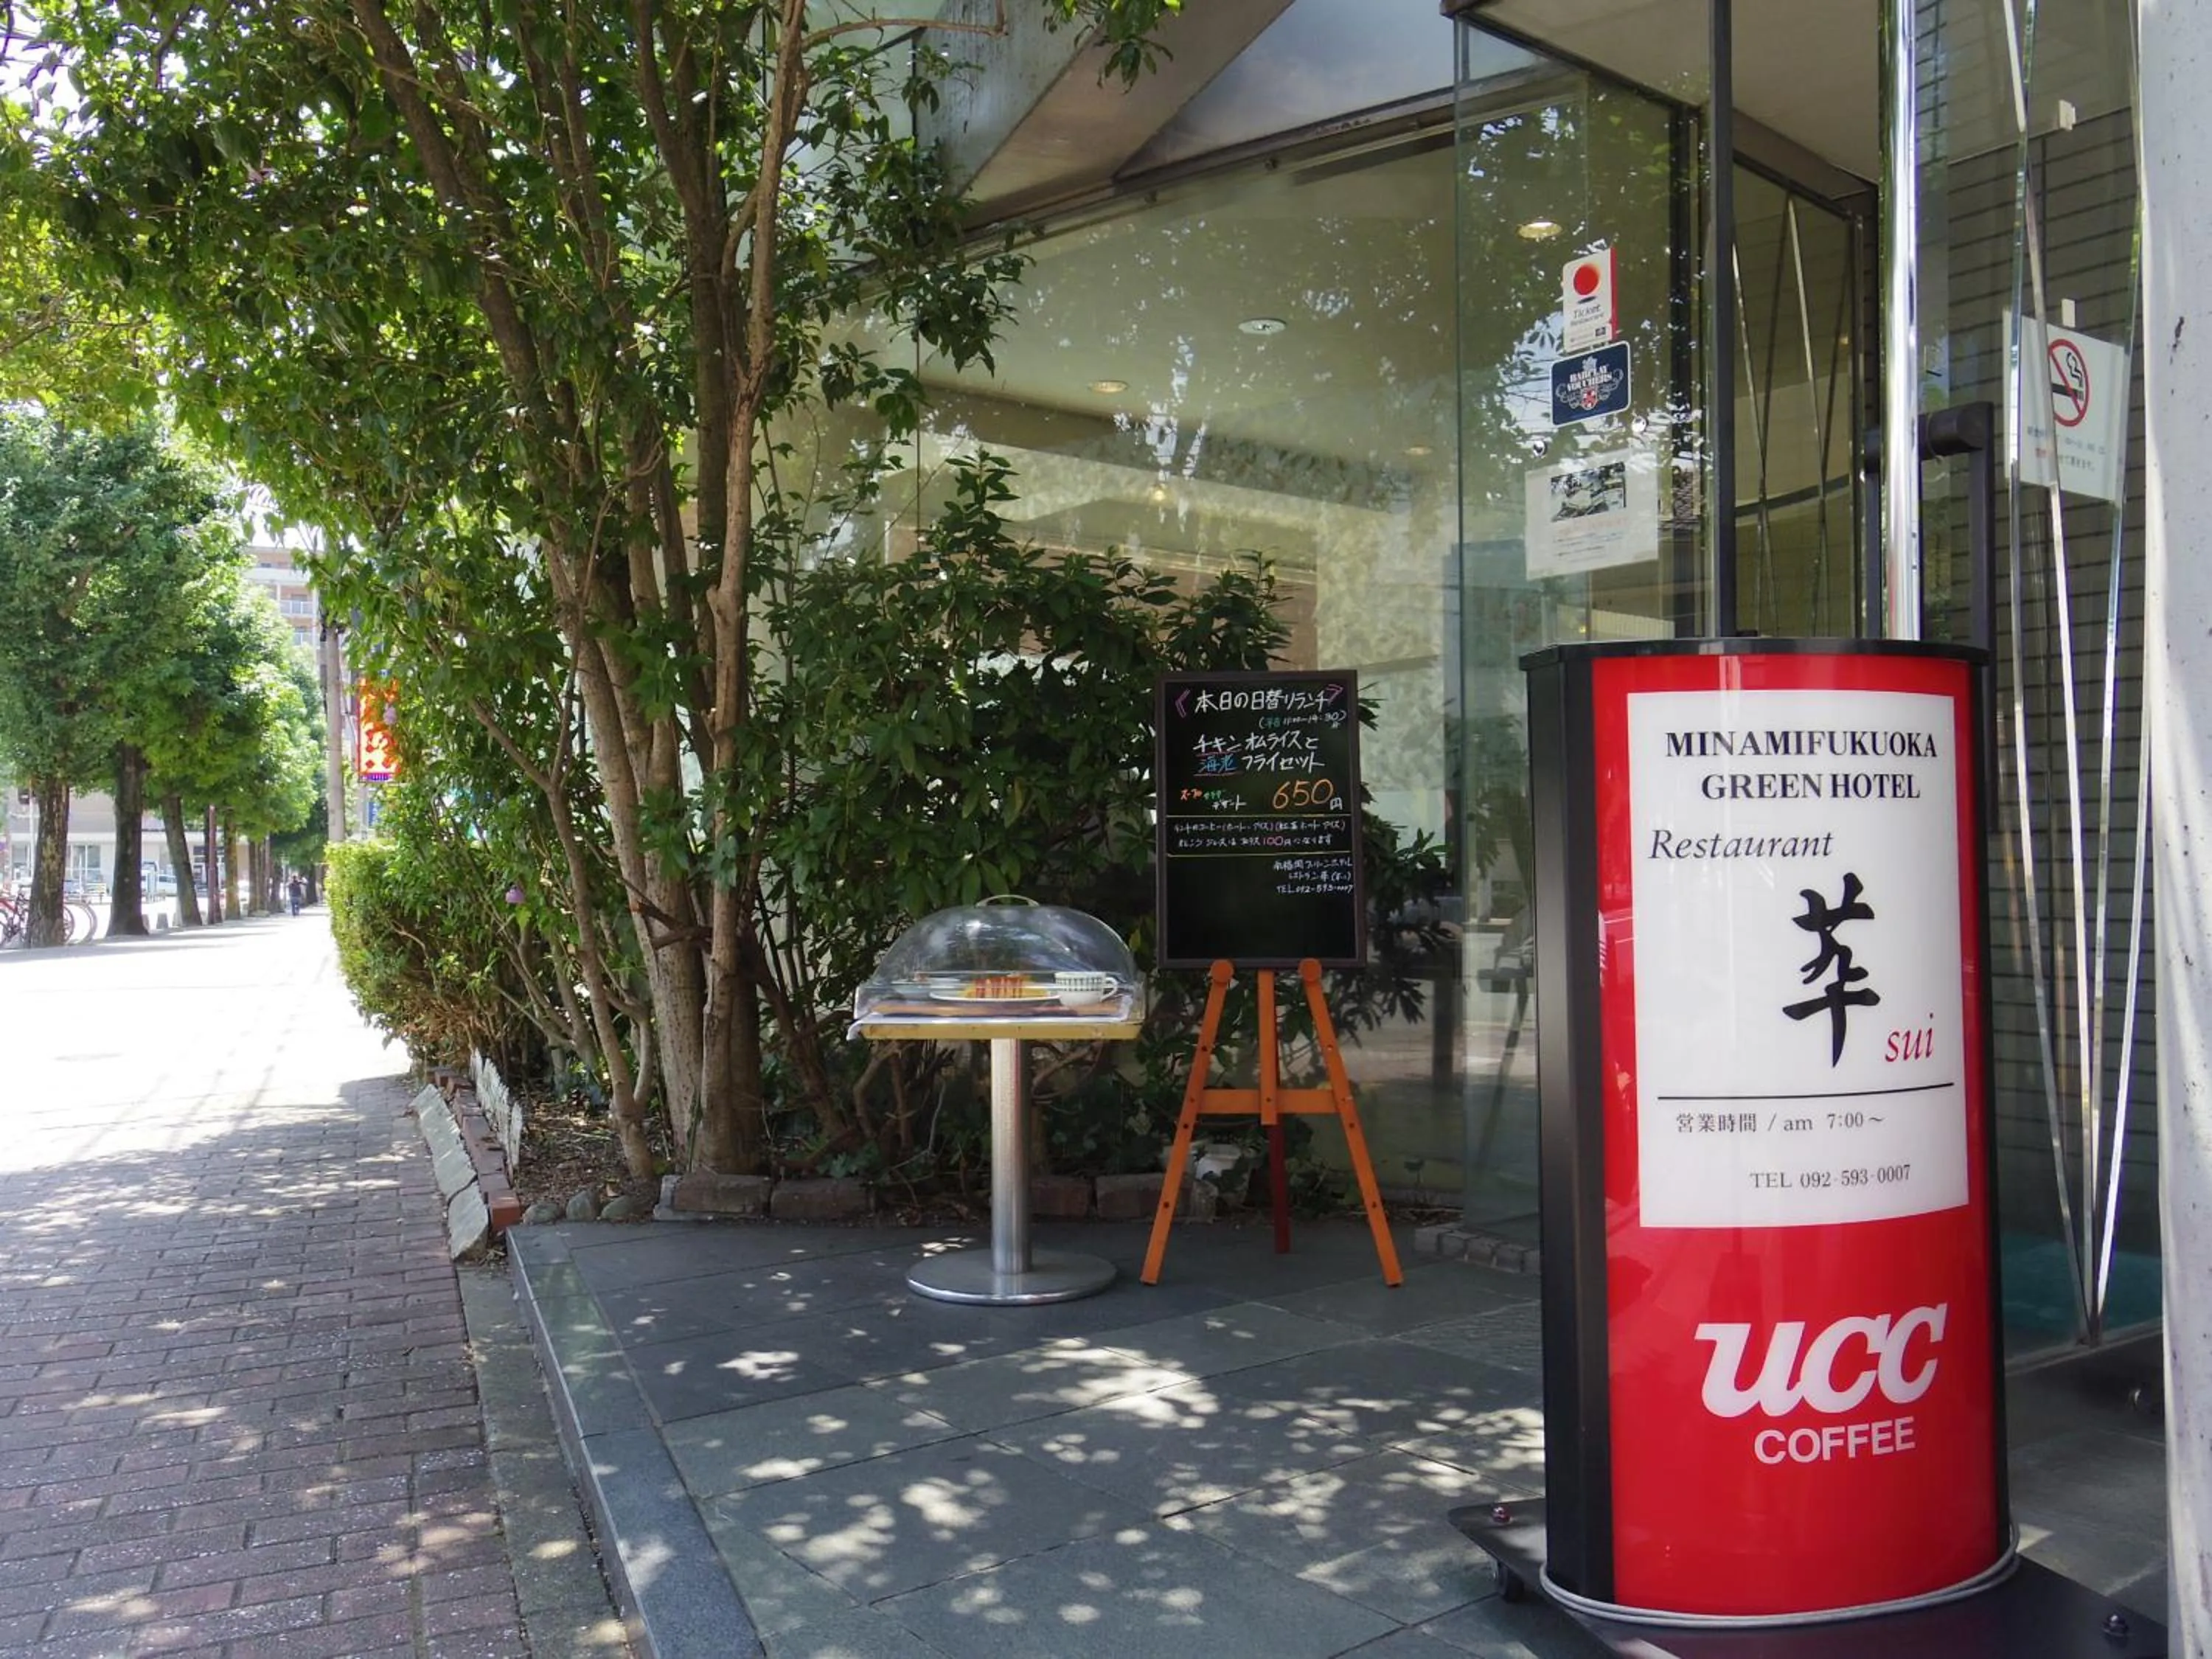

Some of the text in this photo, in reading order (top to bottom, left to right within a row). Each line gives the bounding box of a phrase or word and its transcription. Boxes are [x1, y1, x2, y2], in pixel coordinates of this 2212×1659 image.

[1666, 730, 1938, 758] MINAMIFUKUOKA
[1701, 773, 1921, 800] GREEN HOTEL
[1649, 829, 1834, 859] Restaurant
[1885, 1012, 1934, 1062] sui
[1676, 1113, 1757, 1133] 営業時間
[1750, 1172, 1792, 1189] TEL
[1754, 1416, 1916, 1465] COFFEE
